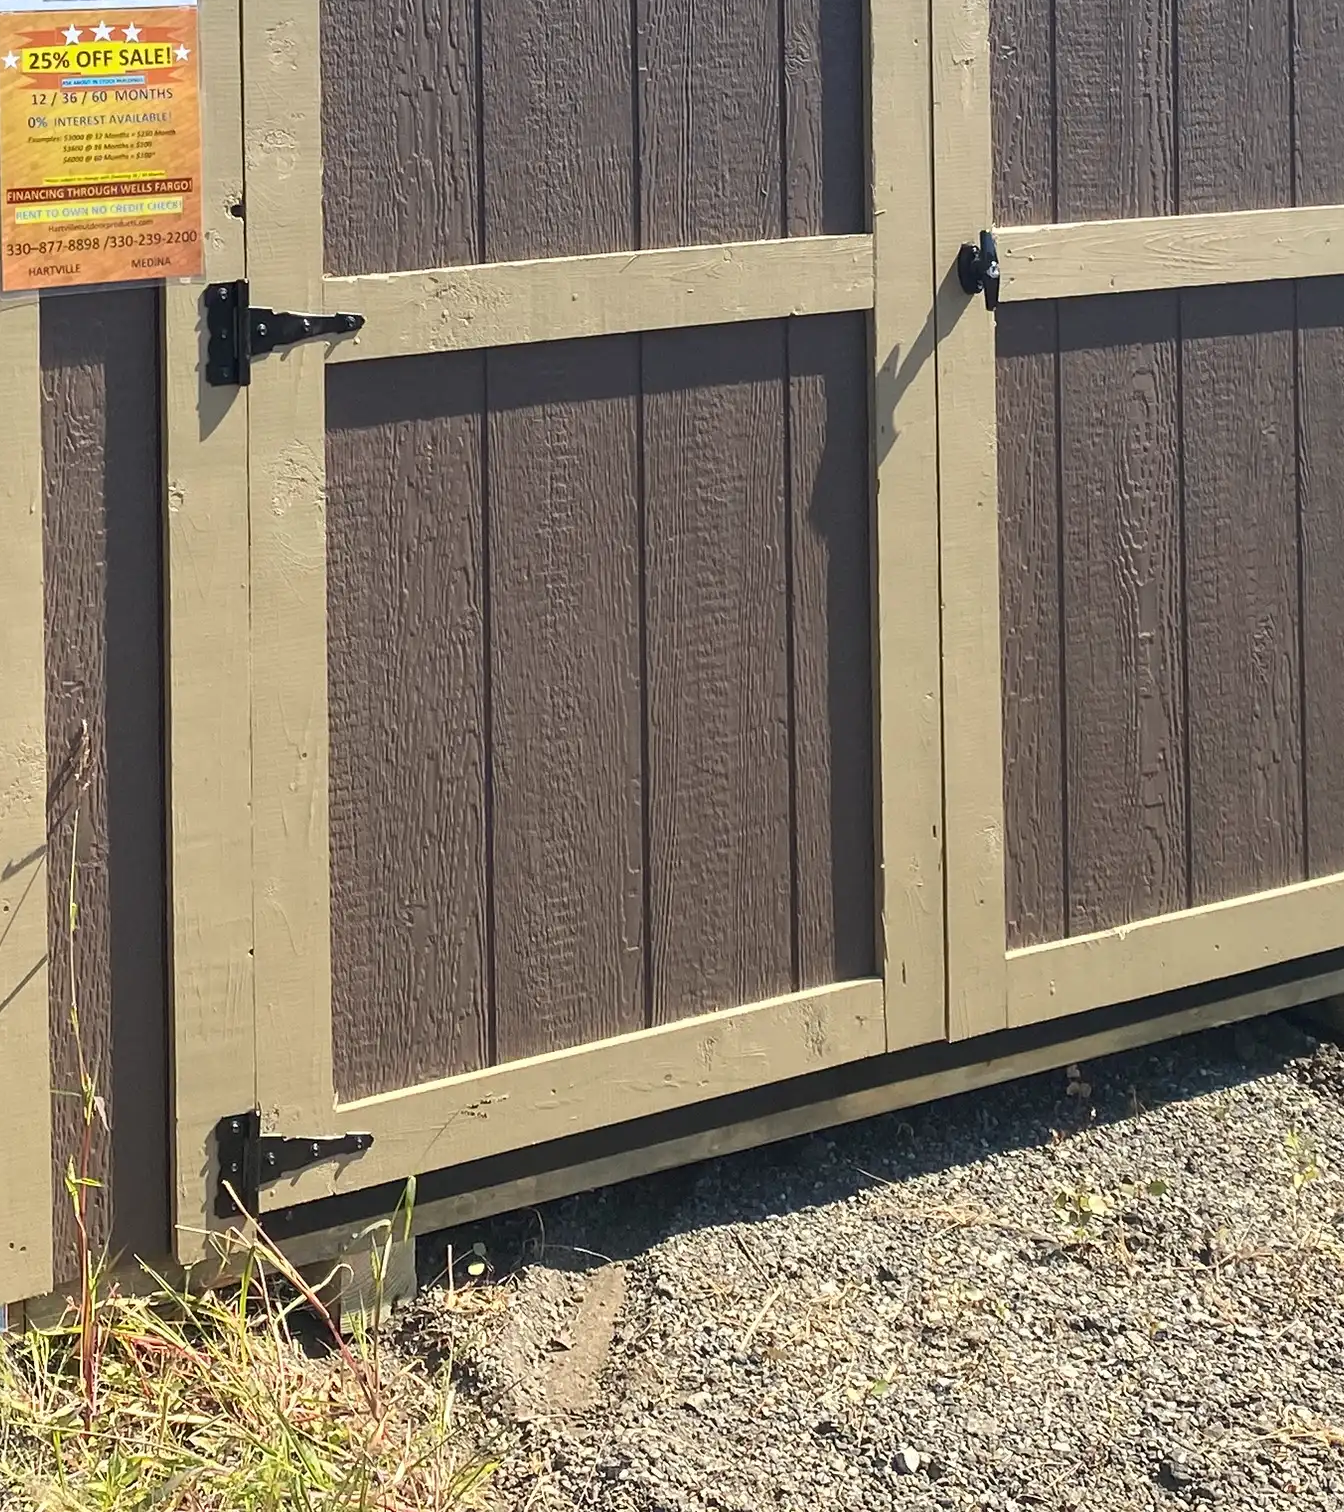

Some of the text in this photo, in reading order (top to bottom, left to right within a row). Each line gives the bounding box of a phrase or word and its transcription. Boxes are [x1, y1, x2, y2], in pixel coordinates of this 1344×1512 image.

[28, 47, 172, 70] 25% OFF SALE!
[32, 88, 173, 107] 12 / 36 / 60 MONTHS
[27, 111, 172, 129] 0% INTEREST AVAILABLE!
[7, 181, 192, 202] FINANCING THROUGH WELLS FARGO!
[15, 200, 182, 220] RENT TO OWN NO CREDIT CHECK!
[28, 256, 171, 277] HARTVILLE MEDINA
